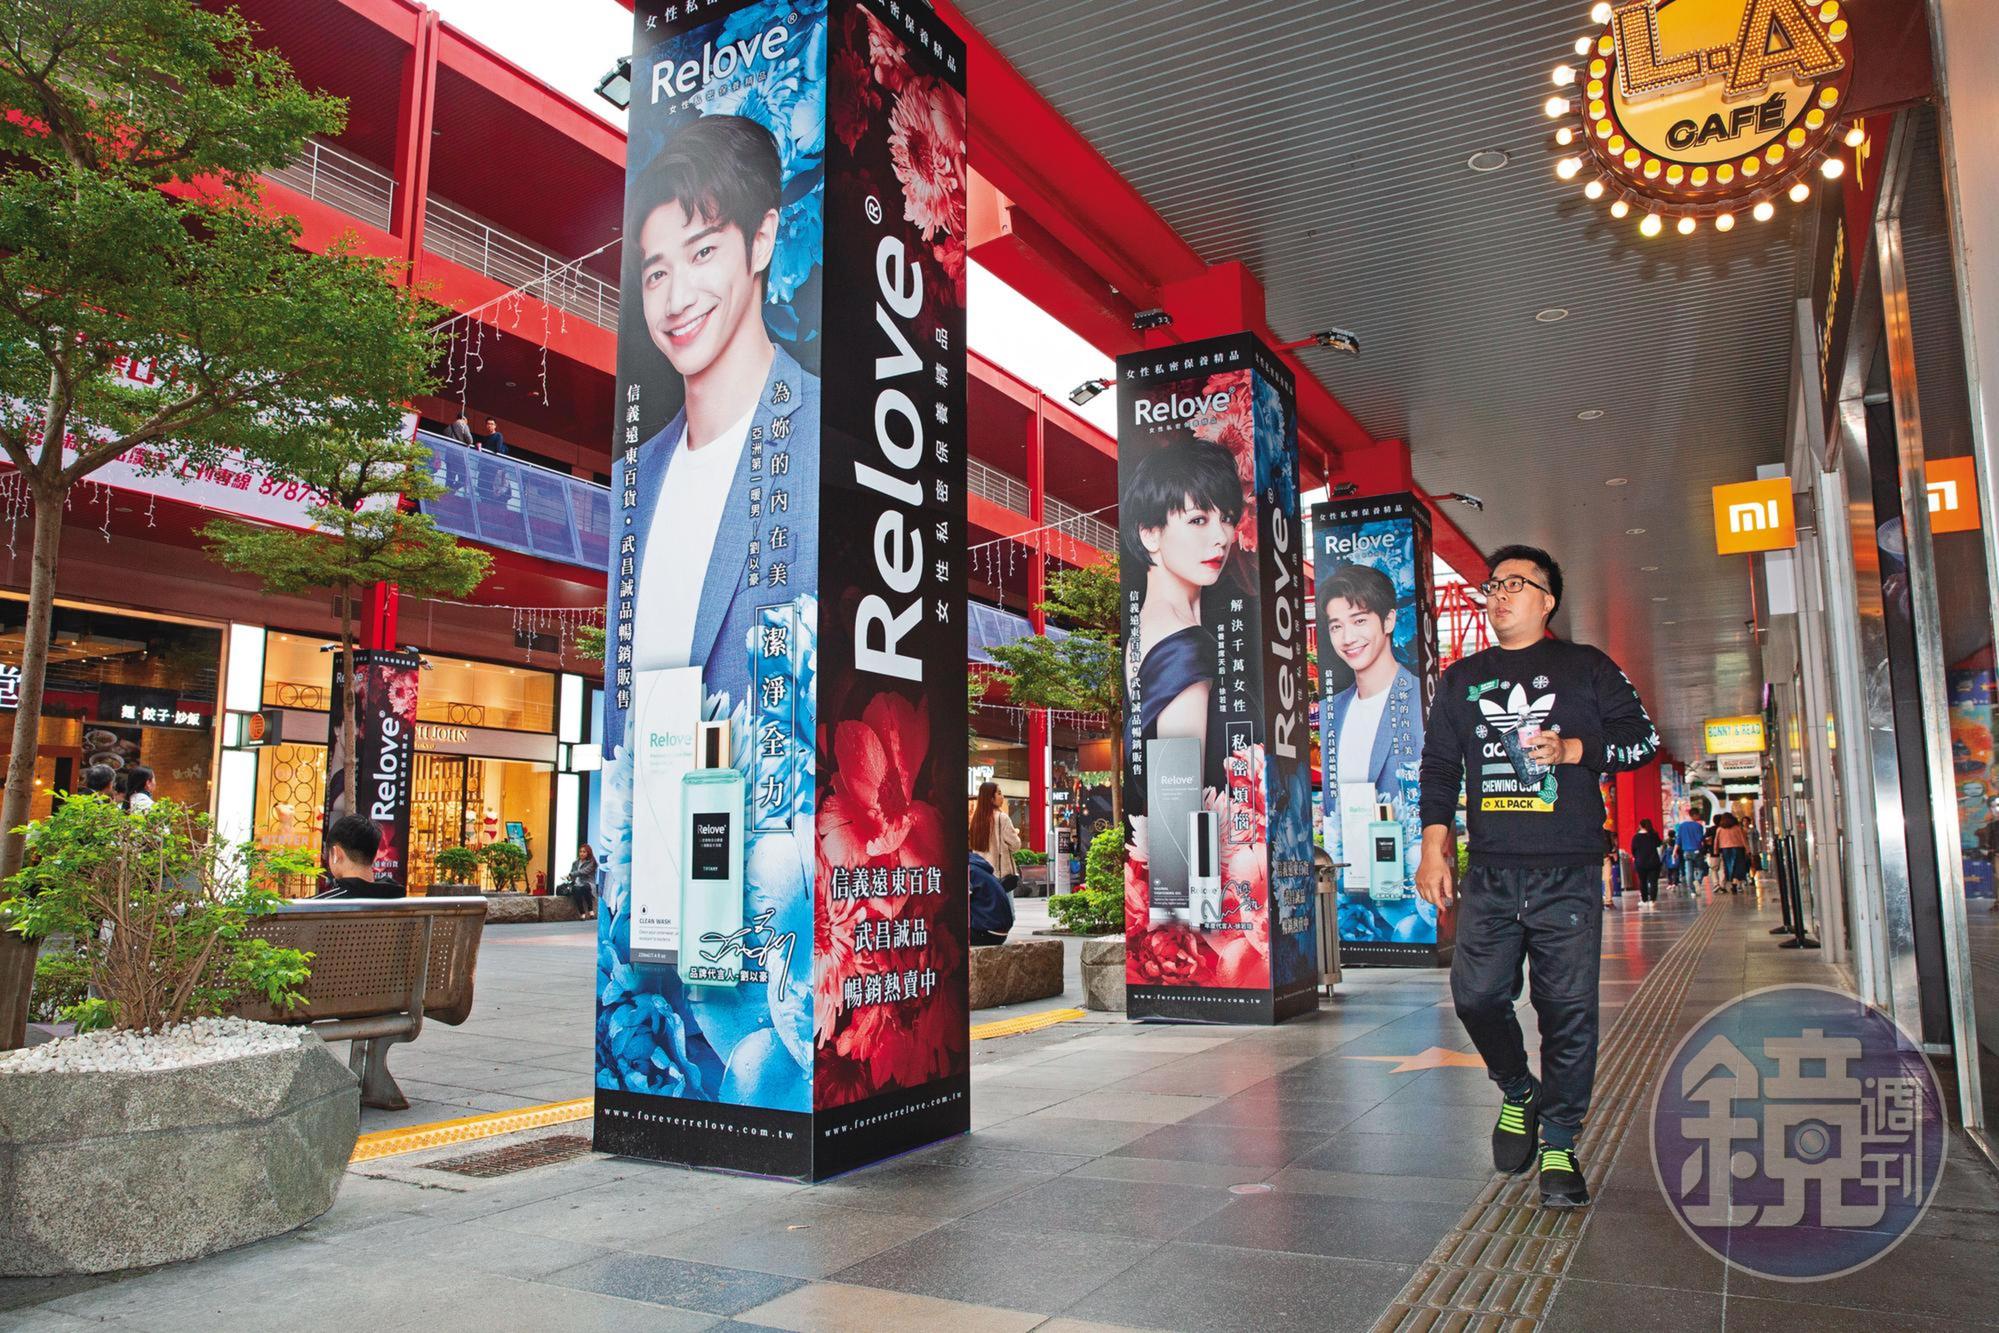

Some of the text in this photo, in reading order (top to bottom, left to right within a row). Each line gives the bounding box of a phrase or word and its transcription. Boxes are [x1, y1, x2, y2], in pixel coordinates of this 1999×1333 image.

[1665, 91, 1787, 151] CAFÉ
[1126, 350, 1240, 379] 女性私密保養精品
[769, 381, 791, 587] 為妳的內在美
[936, 327, 949, 624] 女性私密保養精品
[1230, 599, 1247, 713] 解決千萬女性
[760, 626, 787, 808] 潔淨全力
[1052, 792, 1069, 800] NET
[1231, 733, 1250, 832] 私密煩惱
[1482, 779, 1517, 792] CHEWING
[1494, 800, 1533, 808] XL PACK
[831, 866, 941, 900] 信義遠東百貨
[855, 917, 928, 953] 武昌誠品
[844, 967, 937, 1010] 暢銷熱賣中
[604, 1107, 795, 1141] www.foreverrelove.com.tw
[825, 1090, 963, 1138] www.foreverrelove.com.tw
